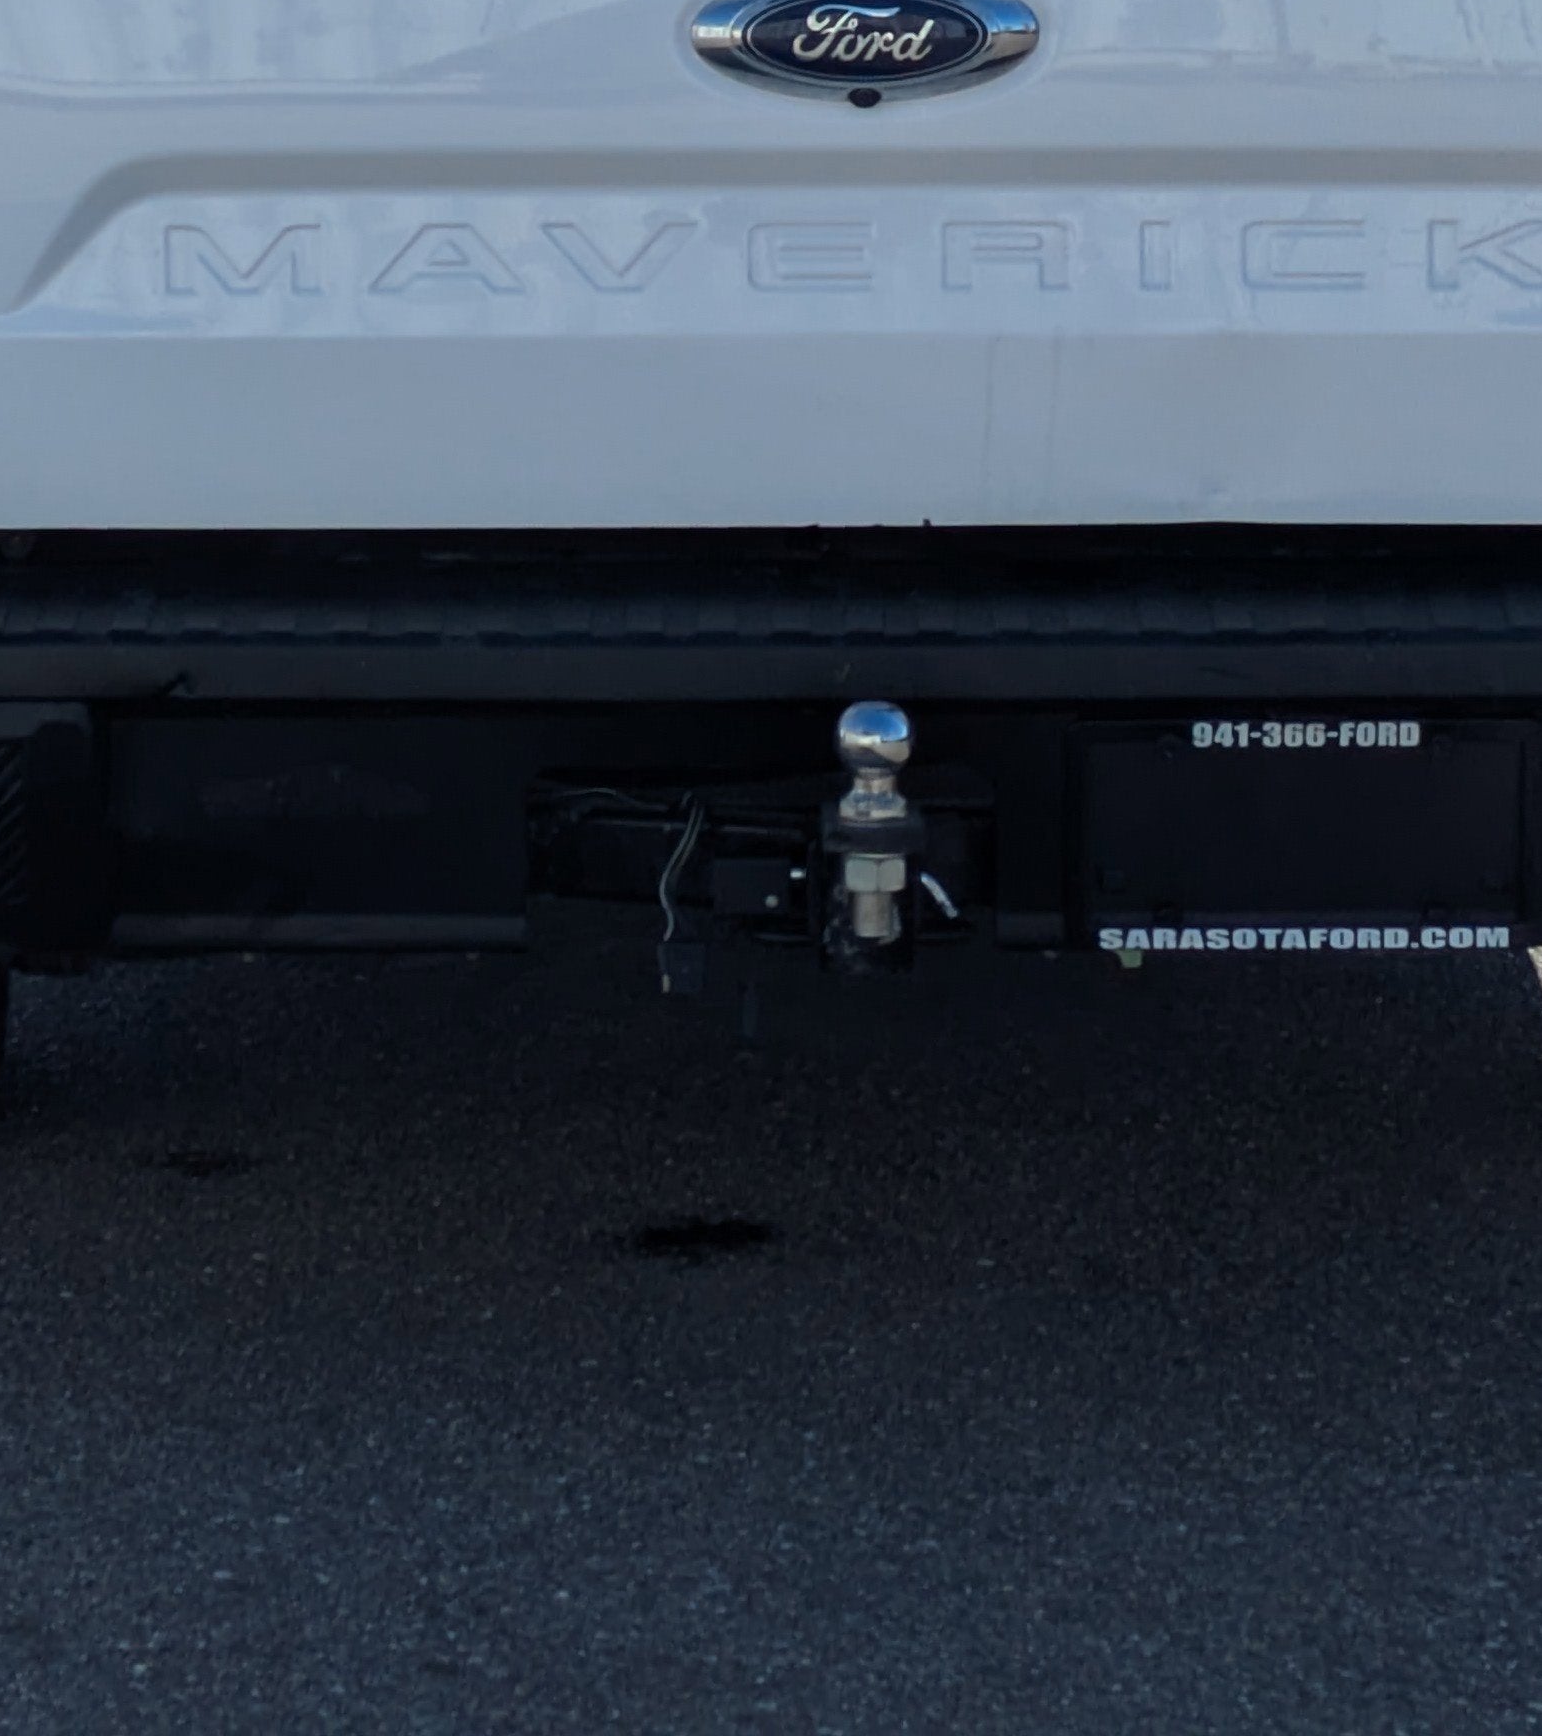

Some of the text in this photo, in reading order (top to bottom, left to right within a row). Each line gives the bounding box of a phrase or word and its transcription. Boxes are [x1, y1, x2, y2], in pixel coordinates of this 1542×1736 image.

[792, 3, 935, 62] Ford
[1191, 721, 1421, 748] 941-366-FORD
[1098, 926, 1511, 950] SARASOTAFORD.COM
